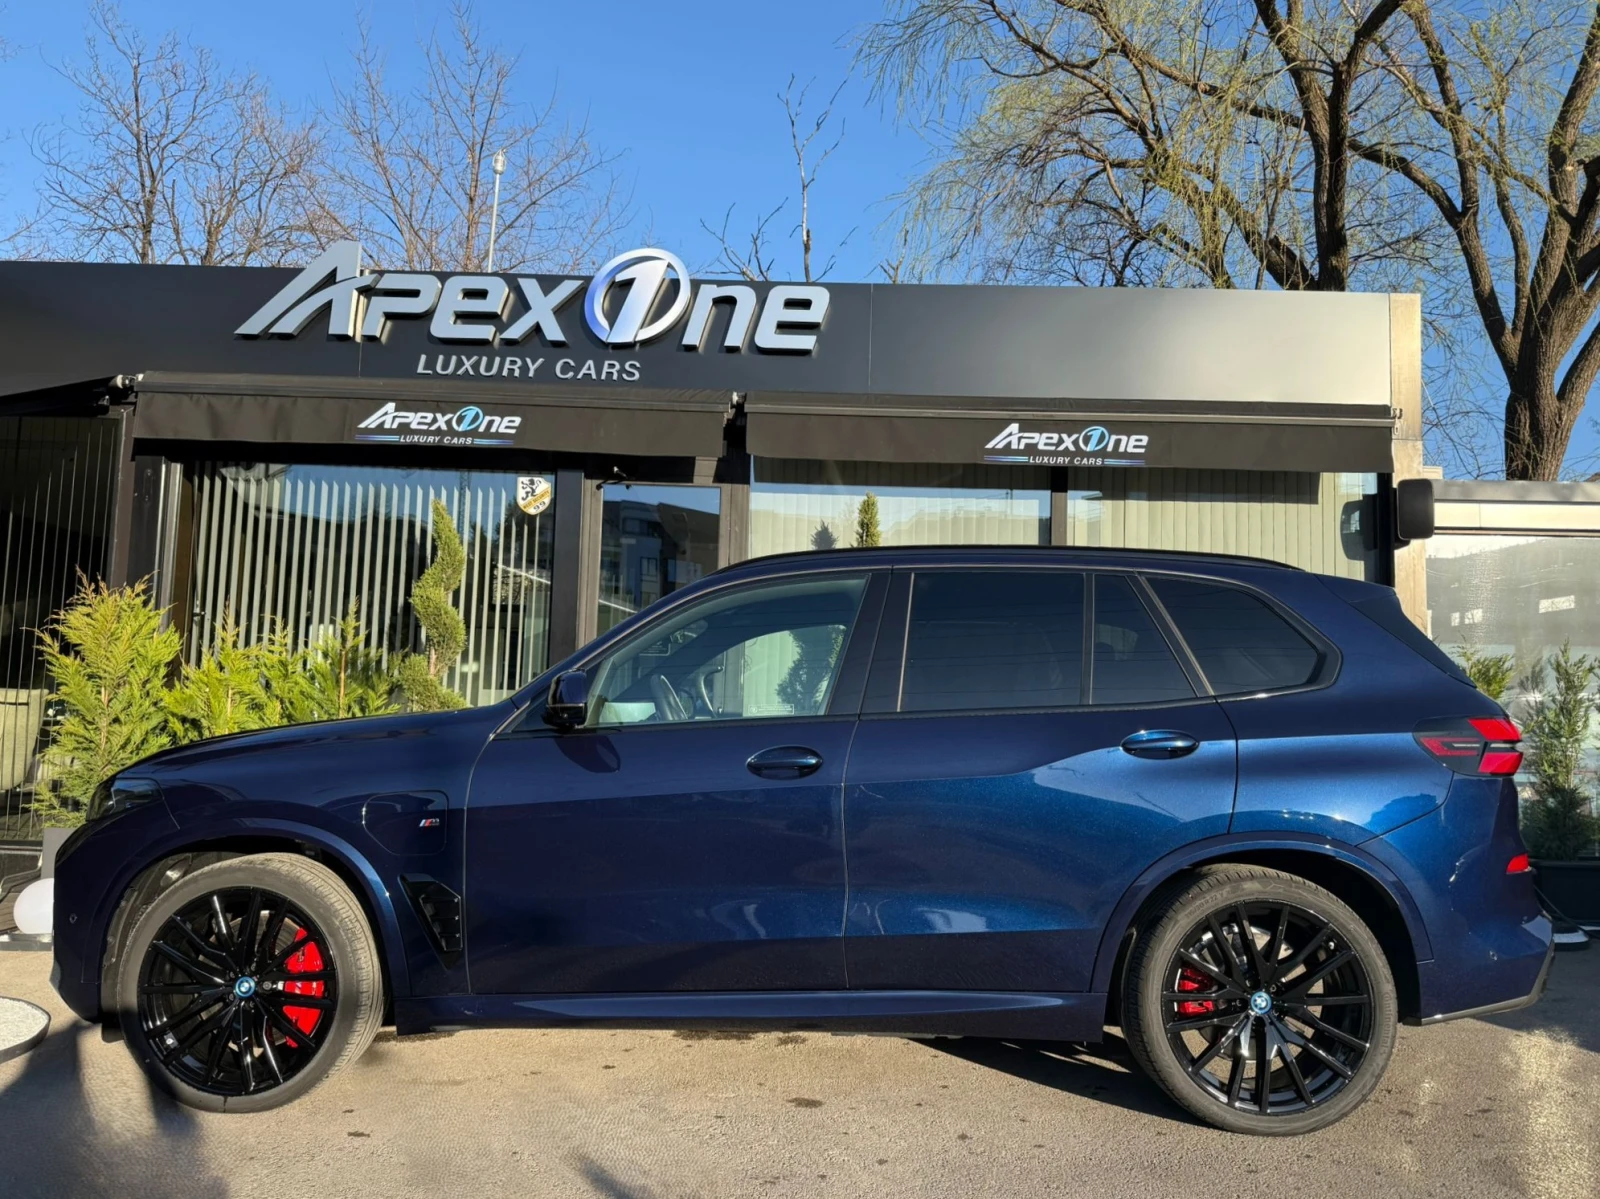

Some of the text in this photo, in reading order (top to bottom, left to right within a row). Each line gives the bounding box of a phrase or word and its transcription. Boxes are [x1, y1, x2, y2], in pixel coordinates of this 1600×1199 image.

[417, 354, 643, 382] LUXURY CARS
[400, 435, 473, 445] LUXURY CARS
[1029, 456, 1103, 465] LUXURY CARS
